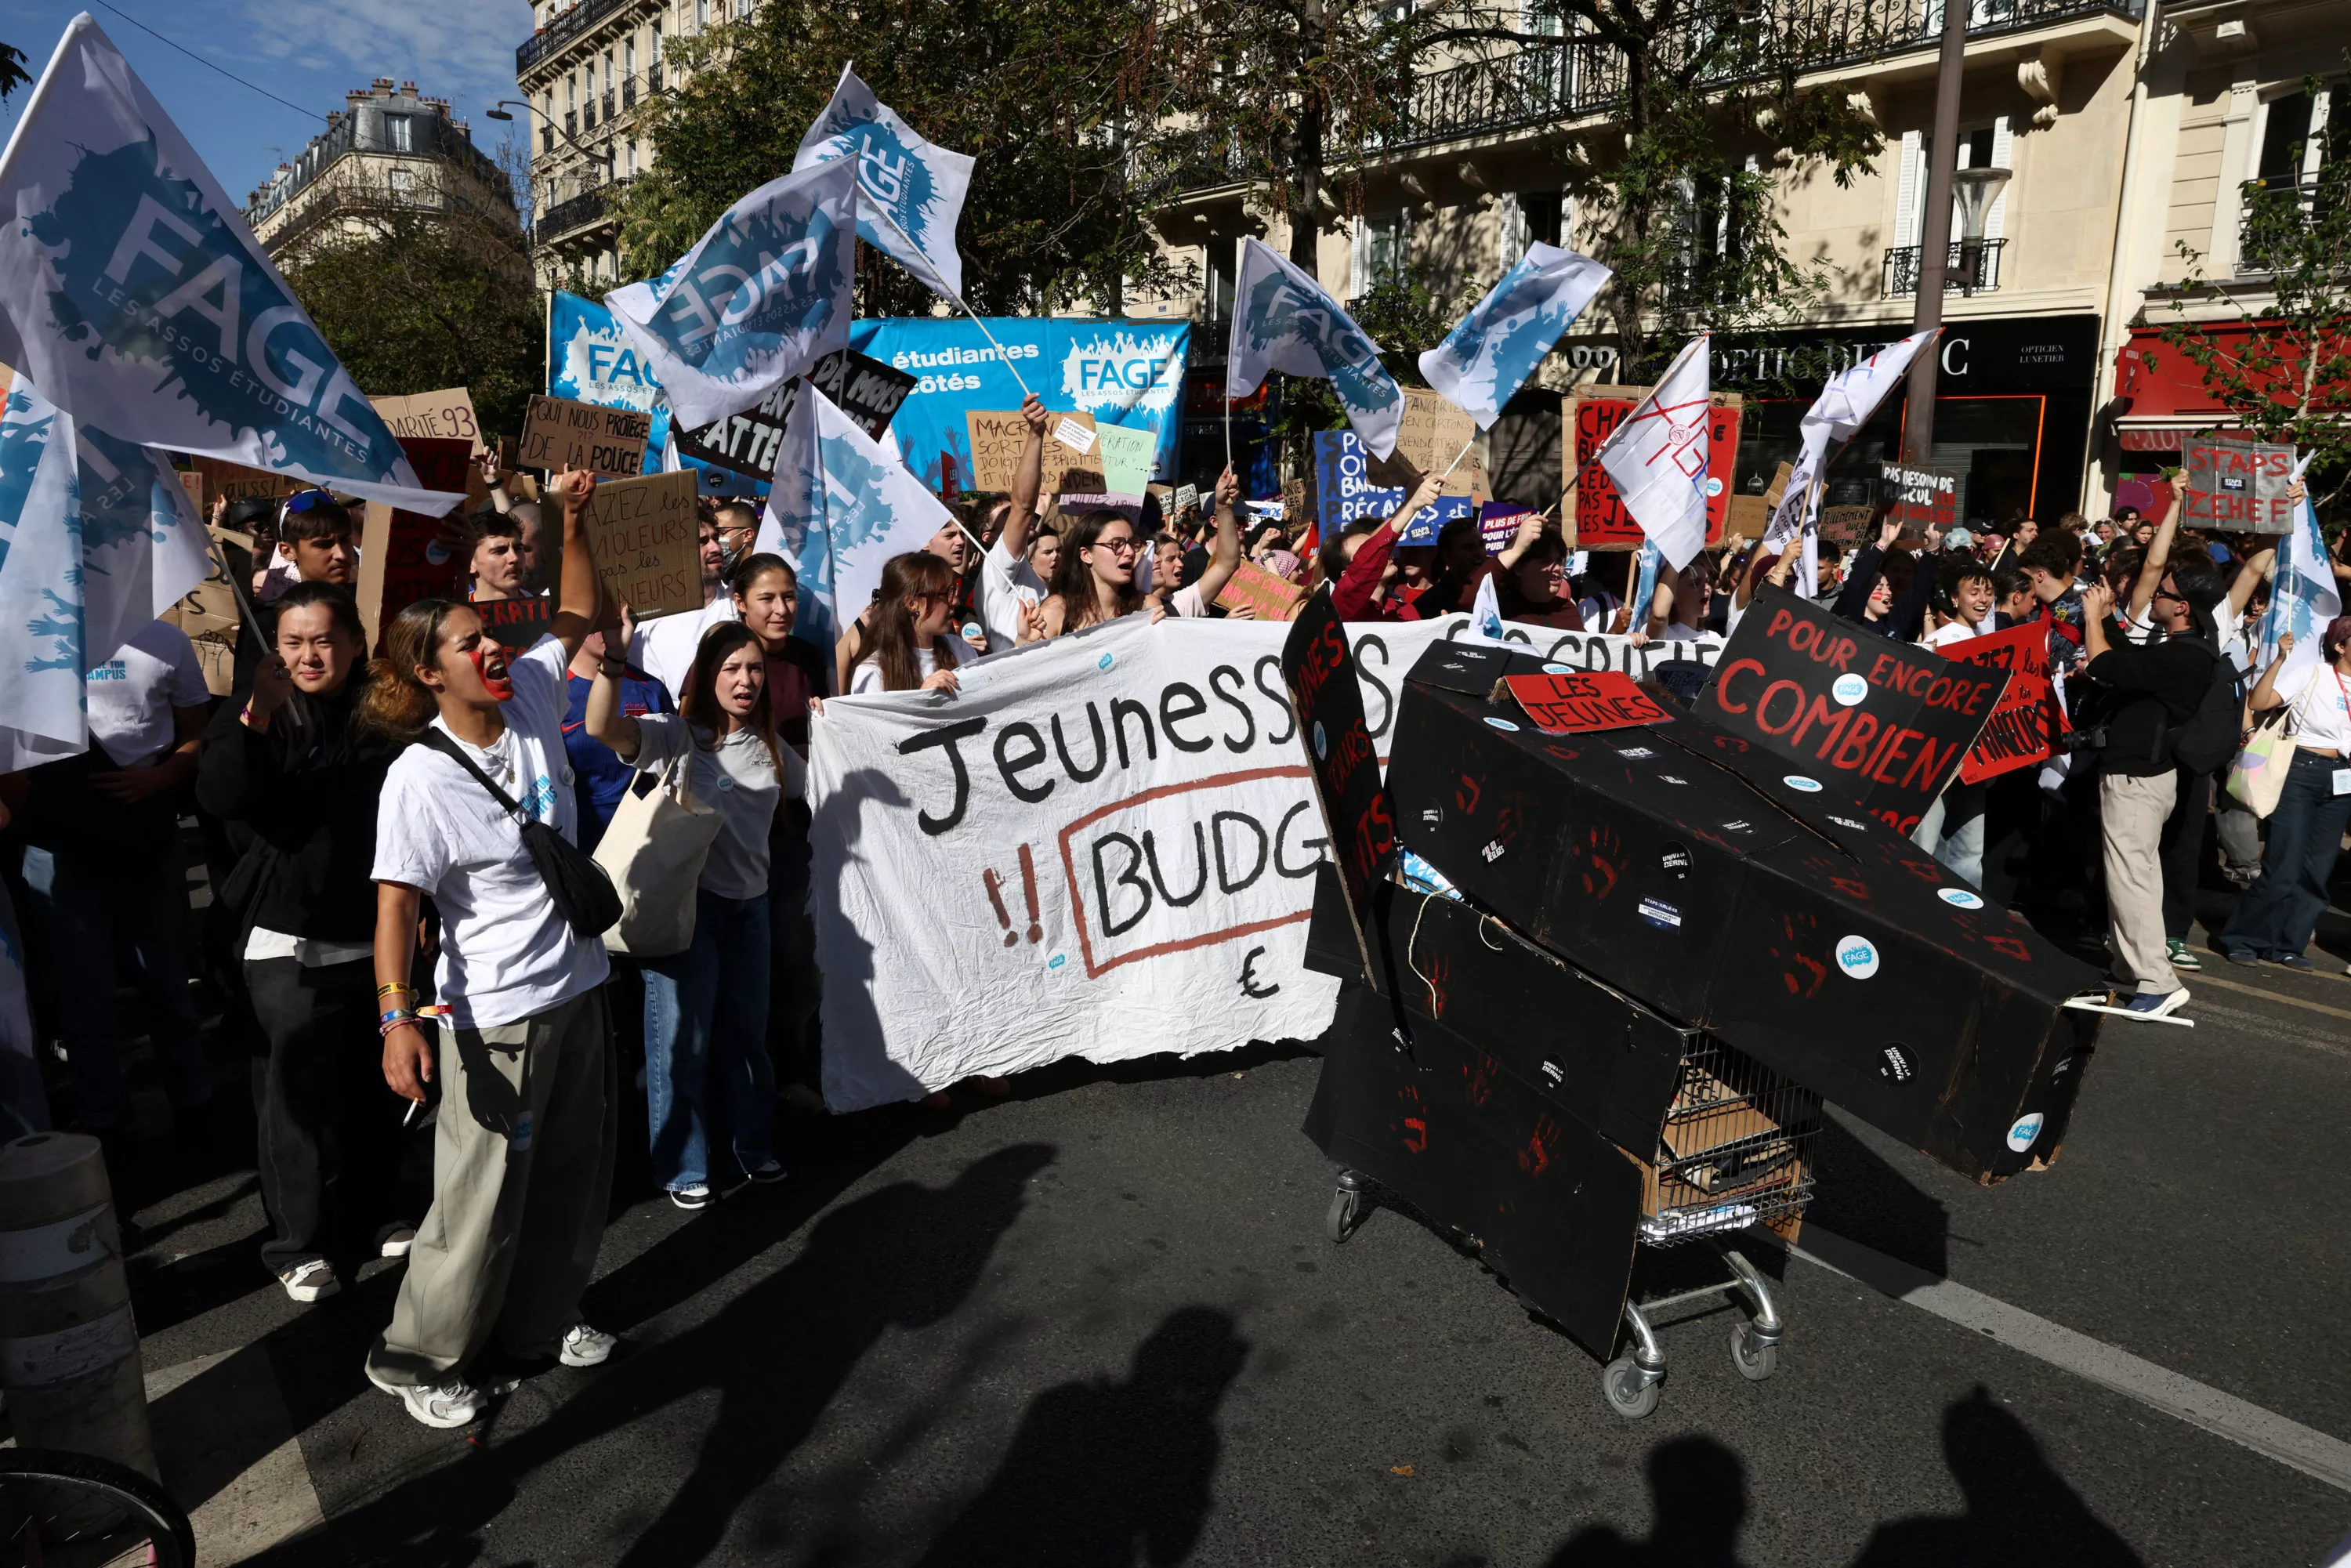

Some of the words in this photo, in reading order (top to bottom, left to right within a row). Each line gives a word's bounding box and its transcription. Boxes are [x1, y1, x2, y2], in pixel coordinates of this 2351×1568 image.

[1262, 317, 1281, 327] LES
[893, 343, 1040, 371] étudiantes
[2021, 344, 2064, 354] OPTICIEN
[2019, 354, 2064, 364] LUNETIER
[92, 277, 139, 316] LES
[145, 316, 223, 373] ASSOS
[230, 369, 367, 464] ÉTUDIANTES
[1080, 358, 1170, 390] FAGE
[608, 384, 638, 393] ASSOS
[1125, 387, 1171, 396] ÉTUDIANTES
[442, 406, 476, 438] 93
[567, 405, 600, 430] NOUS
[605, 412, 650, 440] PROTÈGE
[976, 418, 1055, 438] MACRN
[1184, 425, 1219, 435] EXPRESS
[527, 433, 556, 462] DE
[567, 441, 585, 466] LA
[2189, 446, 2289, 477] STAPS
[984, 473, 993, 486] ET
[1058, 471, 1102, 490] AIDER
[1883, 466, 1902, 483] PAS
[1902, 470, 1938, 488] BESOIN
[1939, 476, 1955, 494] DE
[1578, 491, 1600, 511] PAS
[1907, 487, 1933, 506] CUL
[2186, 489, 2290, 523] ZEHEF
[586, 487, 650, 528] AZEZ
[658, 491, 690, 513] les
[1446, 502, 1468, 518] et
[1484, 518, 1506, 530] PLUS
[1506, 516, 1517, 527] DE
[1578, 514, 1599, 533] LES
[1482, 530, 1505, 541] POUR
[599, 563, 628, 581] pas
[634, 551, 661, 571] les
[607, 569, 687, 610] INEURS
[109, 660, 126, 669] TON
[1766, 608, 1858, 672] POUR
[1867, 653, 1993, 716] ENCORE
[2022, 646, 2040, 677] les
[87, 668, 126, 681] AMPUS
[1548, 676, 1602, 699] LES
[1839, 685, 1860, 693] FAGE
[2018, 683, 2031, 702] les
[1523, 693, 1665, 728] JEUNES
[1716, 657, 1960, 792] COMBIEN
[1662, 854, 1676, 863] UNIV
[1663, 859, 1688, 869] DÉRIVE
[983, 842, 1044, 948] !!
[1092, 800, 1333, 938] BUDG
[1644, 897, 1658, 906] STAPS
[1844, 949, 1870, 963] FAGE
[1238, 946, 1281, 999] €
[1543, 1059, 1556, 1071] UNIV
[1890, 1047, 1905, 1066] UNIV
[1541, 1064, 1563, 1084] DÉRIVE
